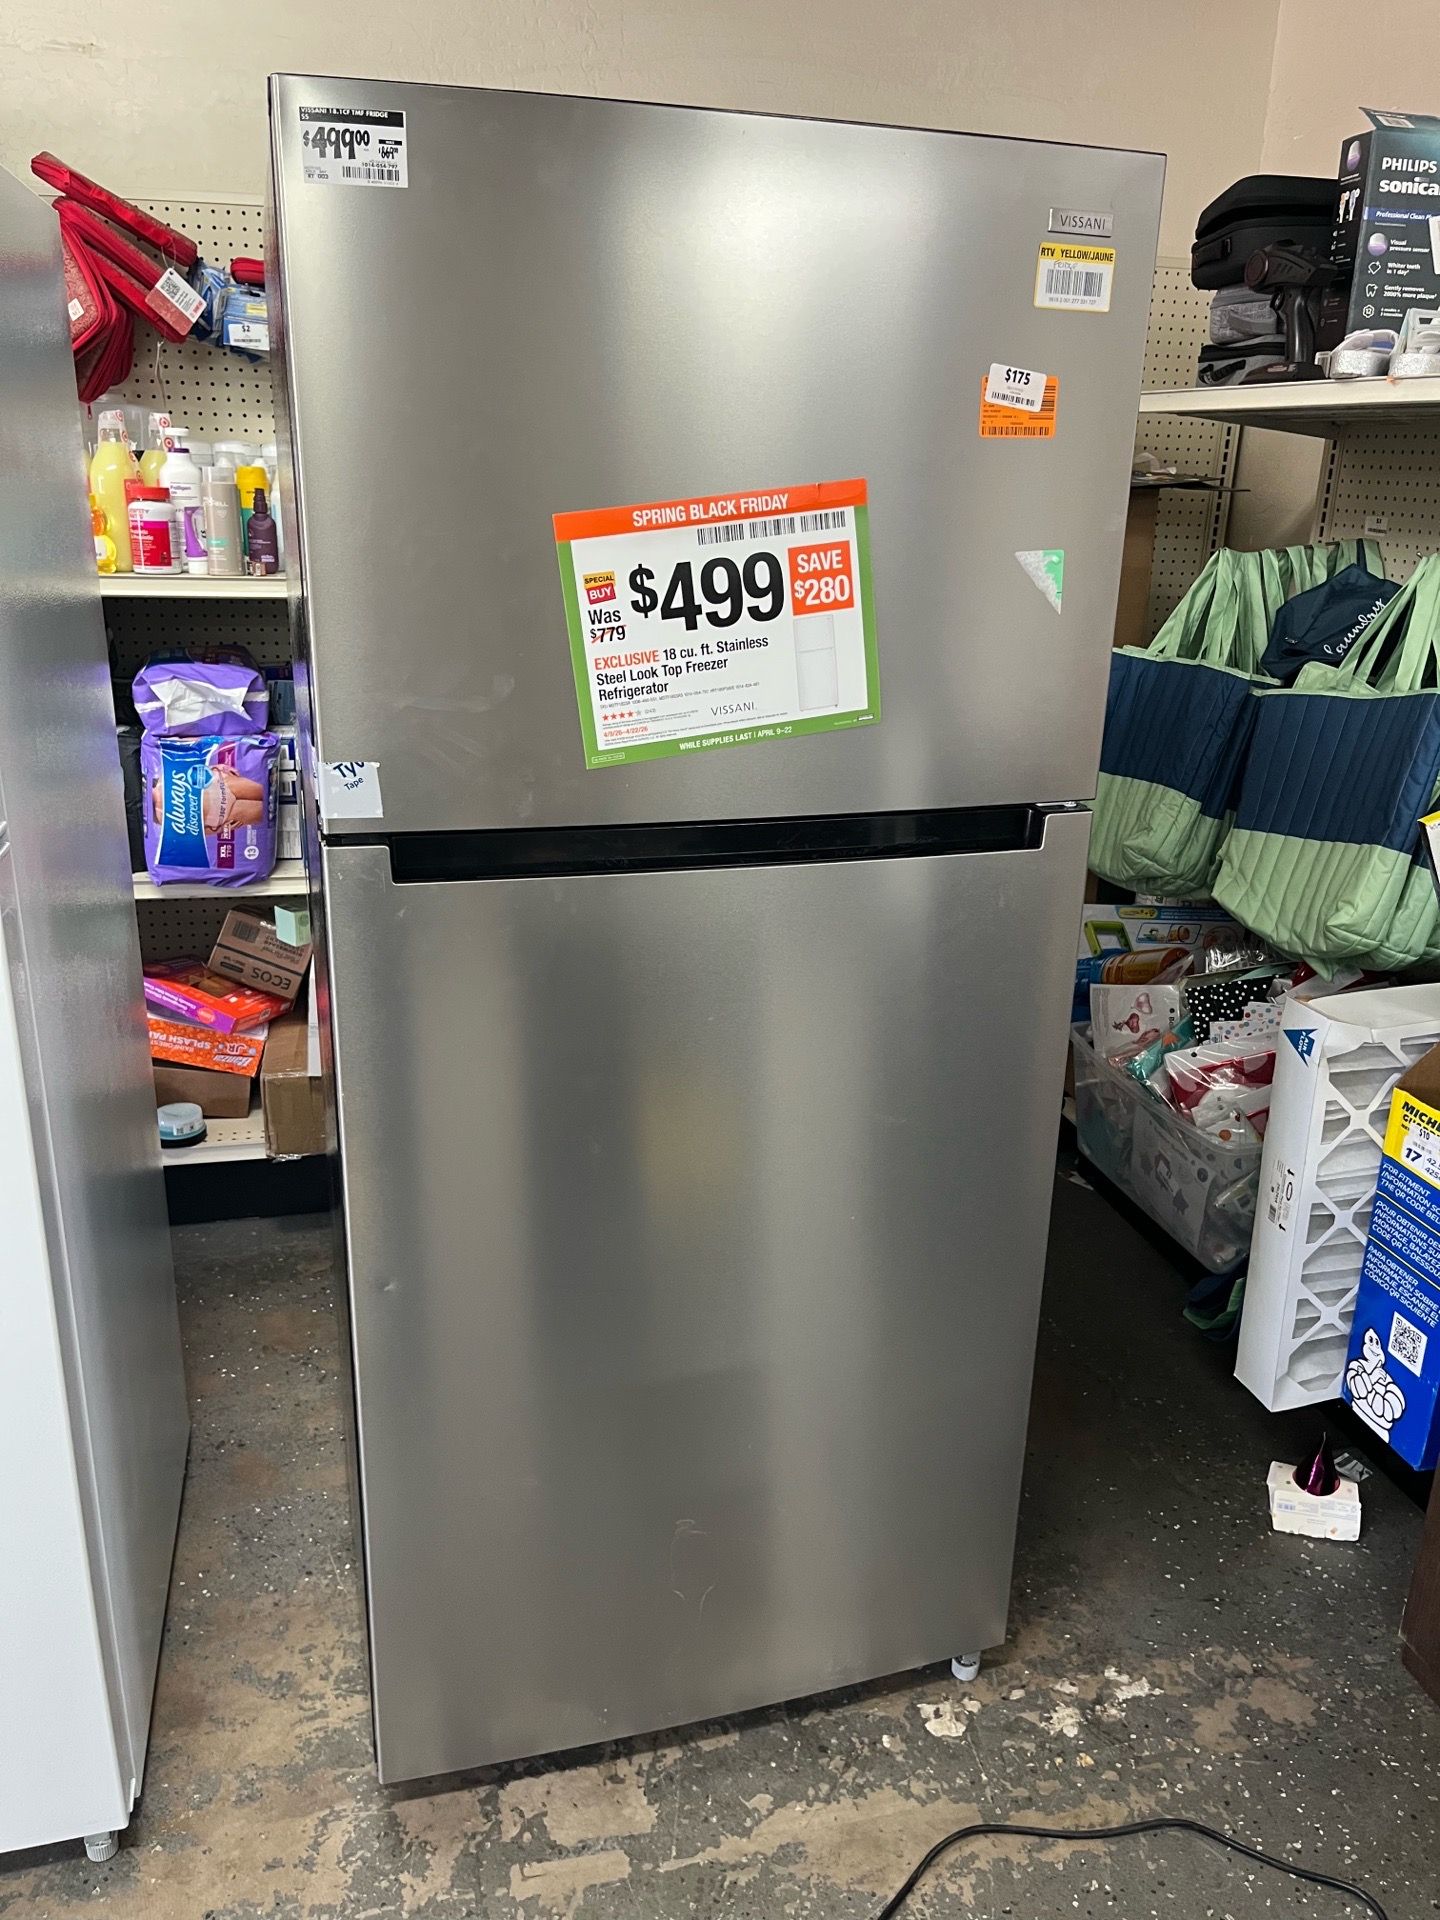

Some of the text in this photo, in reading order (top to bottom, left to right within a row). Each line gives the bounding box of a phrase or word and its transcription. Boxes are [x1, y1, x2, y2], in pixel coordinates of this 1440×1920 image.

[366, 110, 388, 118] FRIDGE
[1381, 156, 1438, 174] PHILIPS
[1379, 176, 1440, 196] sonica
[1060, 214, 1106, 231] VISSANI
[1410, 212, 1425, 220] Clean
[1040, 247, 1114, 262] RTV YELLOW/JAUNE
[1384, 284, 1402, 292] Gently
[1004, 368, 1031, 386] $175
[632, 493, 788, 527] SPRING BLACK FRIDAY
[796, 548, 843, 574] SAVE
[584, 575, 614, 584] SPECIAL
[793, 574, 850, 606] $280
[589, 586, 612, 600] BUY
[628, 551, 784, 631] $499
[588, 608, 622, 626] Was
[590, 625, 626, 643] $779
[594, 637, 769, 670] EXCLUSIVE 18 cu. ft. Stainless
[596, 658, 729, 686] Steel Look Top Freezer
[598, 682, 669, 702] Refrigerator
[678, 740, 701, 751] WHILE
[702, 735, 734, 748] SUPPLIES
[735, 732, 752, 742] LAST
[757, 729, 775, 738] APRIL
[344, 778, 364, 791] Tape
[164, 769, 189, 835] always
[186, 794, 200, 836] discreet
[246, 848, 257, 858] 13
[250, 966, 293, 990] ECOS
[169, 1032, 212, 1050] SPLASH
[227, 1041, 248, 1056] JR
[1405, 1147, 1422, 1162] 17
[1382, 1162, 1431, 1197] FOR FITMENT
[1381, 1170, 1440, 1216] INFORMATION SC
[1381, 1178, 1440, 1225] THE QR CODE BEL
[1374, 1208, 1428, 1250] INFORMATIONS
[1376, 1200, 1397, 1218] POUR
[1396, 1214, 1428, 1240] OBTENIR
[1372, 1224, 1392, 1241] CODE
[1390, 1238, 1402, 1249] QR
[1368, 1245, 1419, 1286] PARA OBTENER
[1389, 1288, 1400, 1300] QR
[1399, 1296, 1438, 1328] SIGUIENTE
[1398, 1286, 1431, 1314] ESCANEE
[1430, 1311, 1440, 1323] EL
[1413, 1289, 1440, 1312] SOBRE
